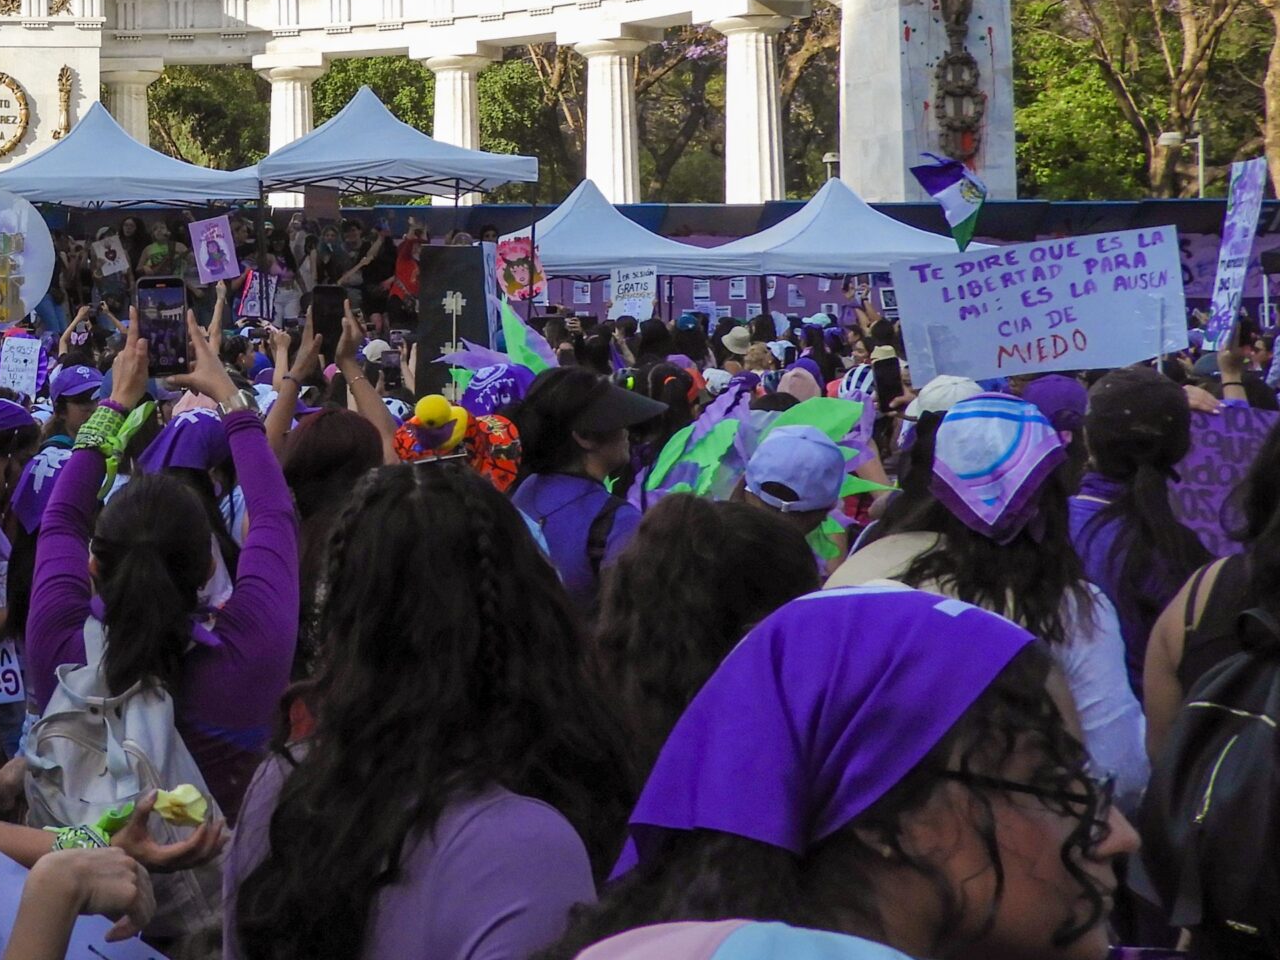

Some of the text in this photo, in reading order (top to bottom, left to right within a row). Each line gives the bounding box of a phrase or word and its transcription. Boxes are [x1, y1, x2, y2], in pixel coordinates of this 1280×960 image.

[955, 250, 1020, 277] DIRE
[1030, 240, 1080, 262] QUE
[1097, 236, 1122, 253] ES
[1138, 230, 1164, 248] LA
[618, 282, 649, 294] GRATIS
[942, 264, 1062, 303] LIBERTAD
[1084, 251, 1147, 275] PARA
[1021, 286, 1053, 308] ES
[1070, 278, 1098, 298] LA
[998, 306, 1078, 338] CIA DE
[997, 328, 1088, 368] MIEDO
